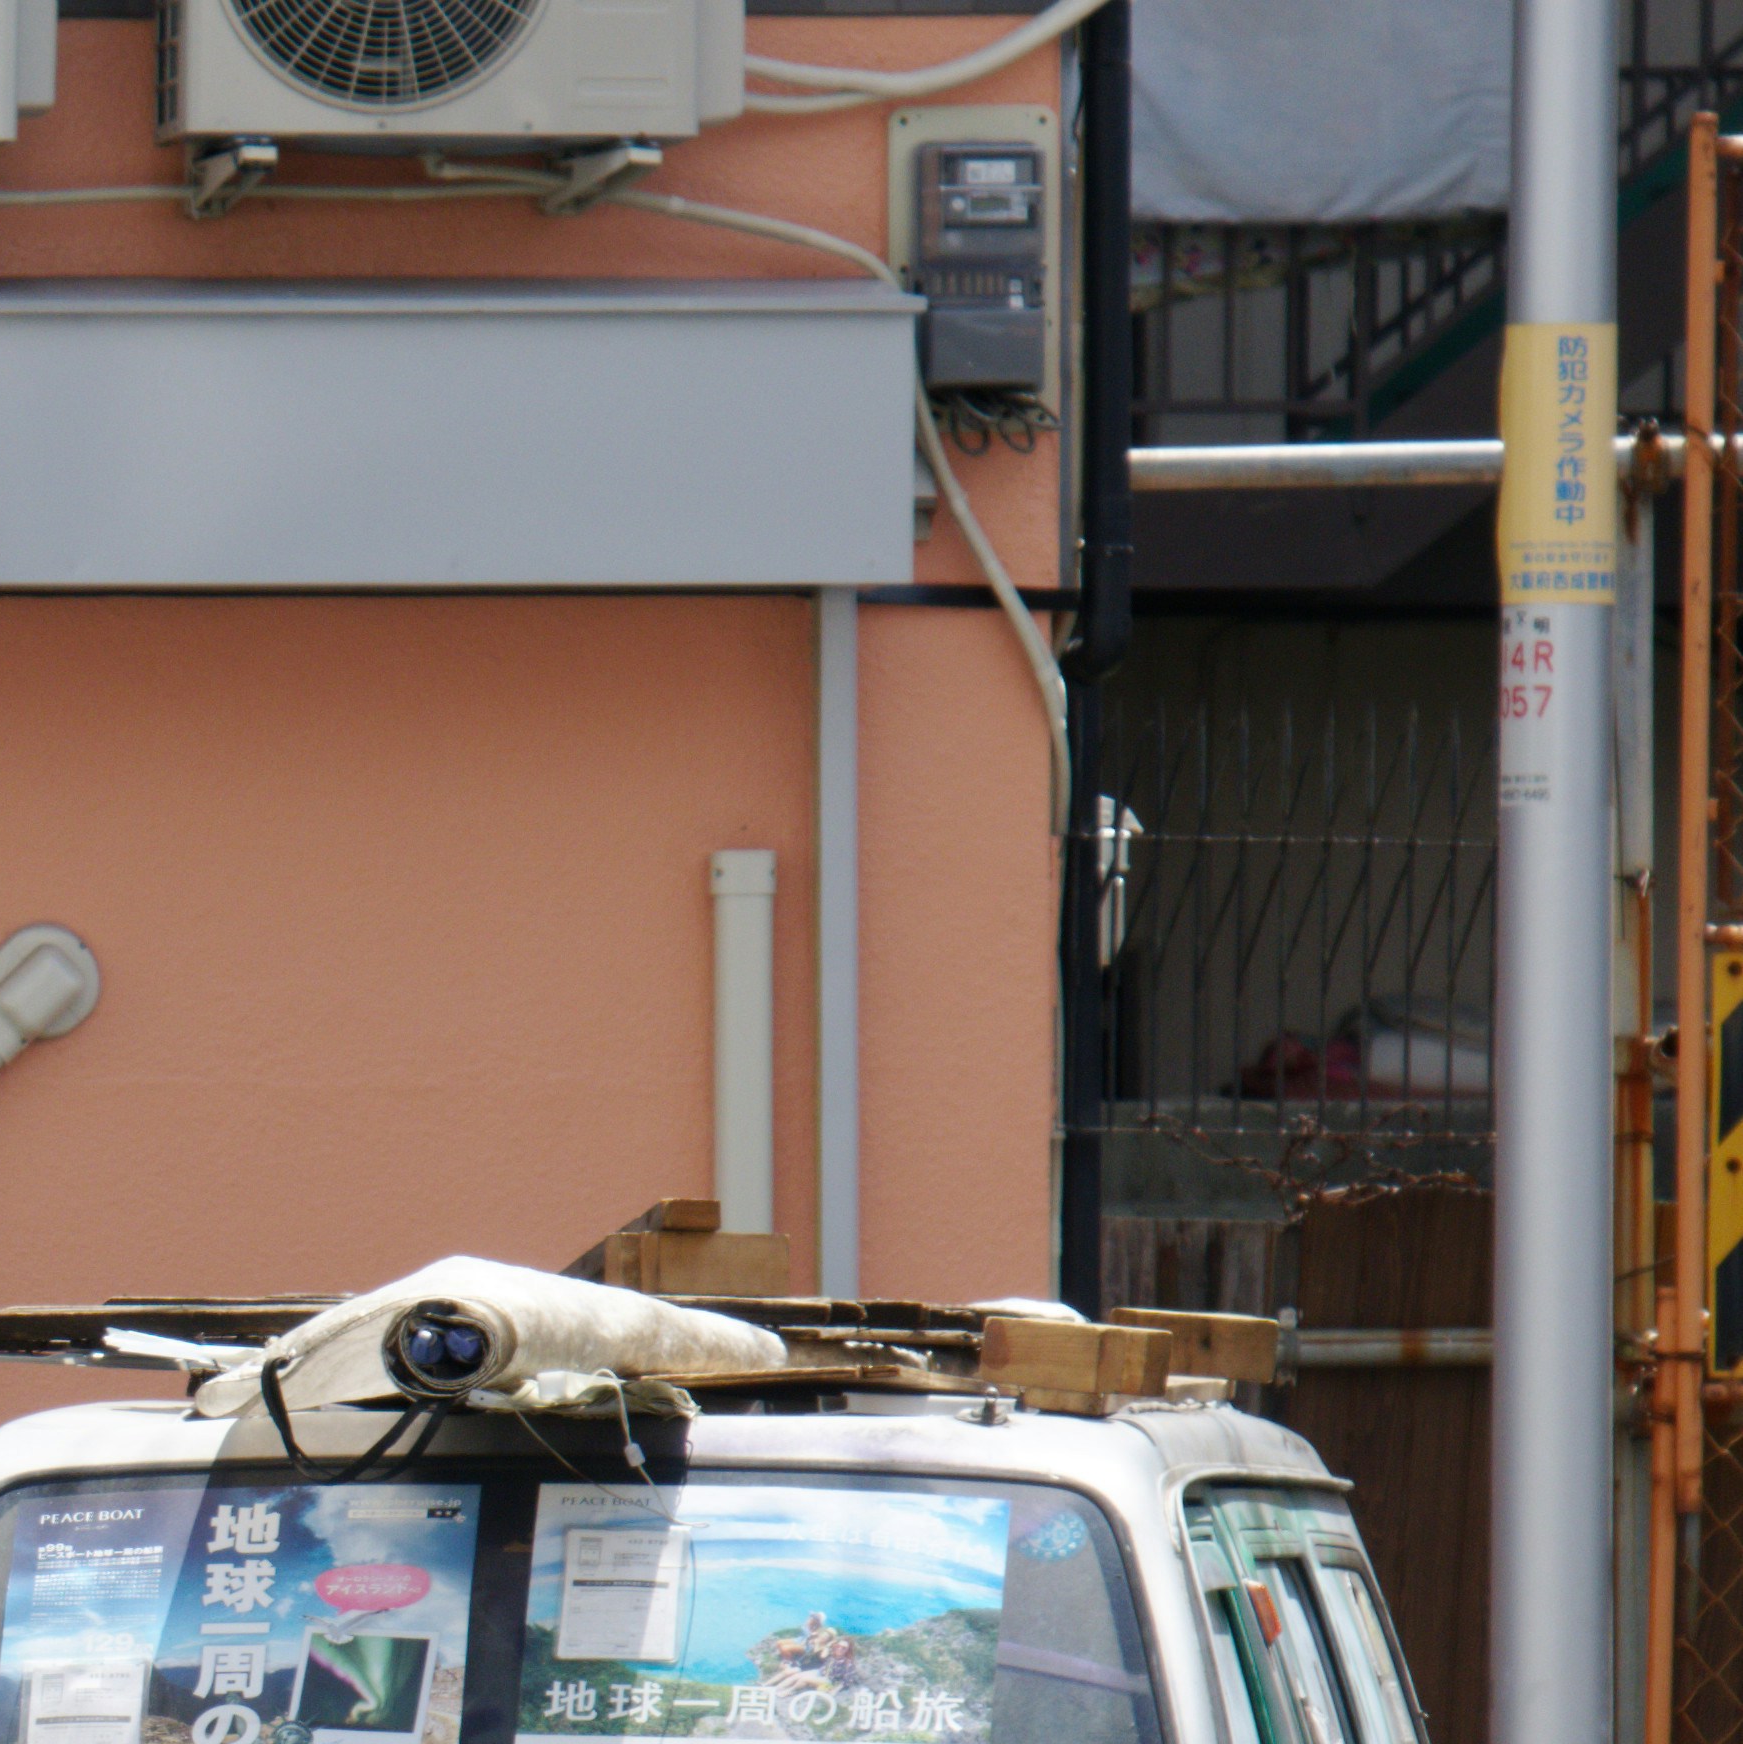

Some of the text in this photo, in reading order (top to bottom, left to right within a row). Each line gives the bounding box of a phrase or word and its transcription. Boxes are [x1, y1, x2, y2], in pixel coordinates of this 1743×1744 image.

[1555, 336, 1588, 526] 防犯カメラ作動中
[39, 1508, 145, 1526] PEACE BOAT
[561, 1496, 608, 1506] PEACE
[542, 1678, 966, 1735] 地球一周の船旅
